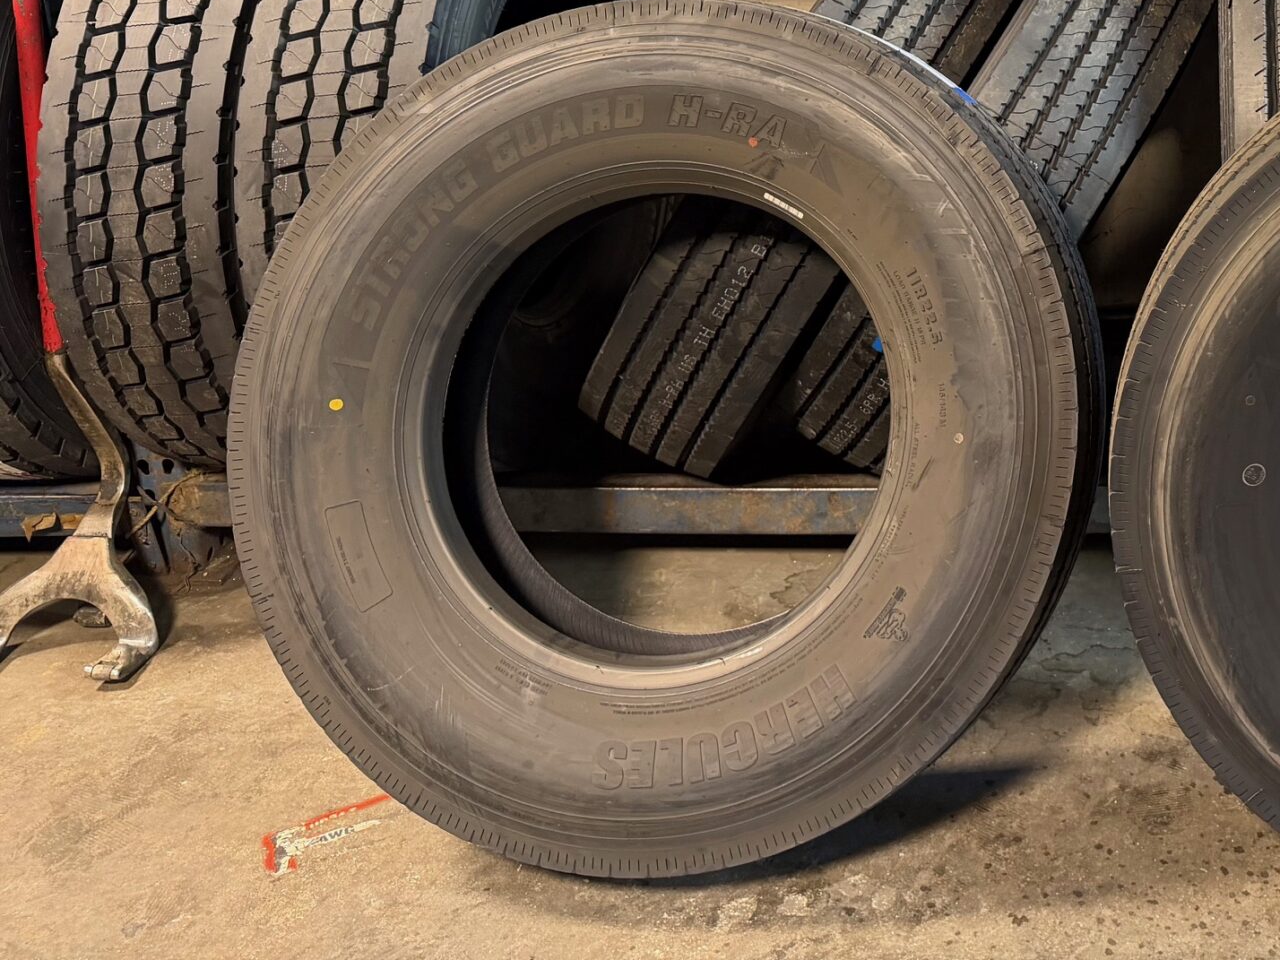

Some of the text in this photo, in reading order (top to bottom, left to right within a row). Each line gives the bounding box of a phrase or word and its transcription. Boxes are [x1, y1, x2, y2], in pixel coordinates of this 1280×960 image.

[350, 94, 788, 331] STRONG GUARD H-RA
[694, 324, 716, 347] TH
[711, 265, 755, 322] EH012
[906, 266, 944, 346] 11R22.5
[592, 663, 858, 790] HERCULES
